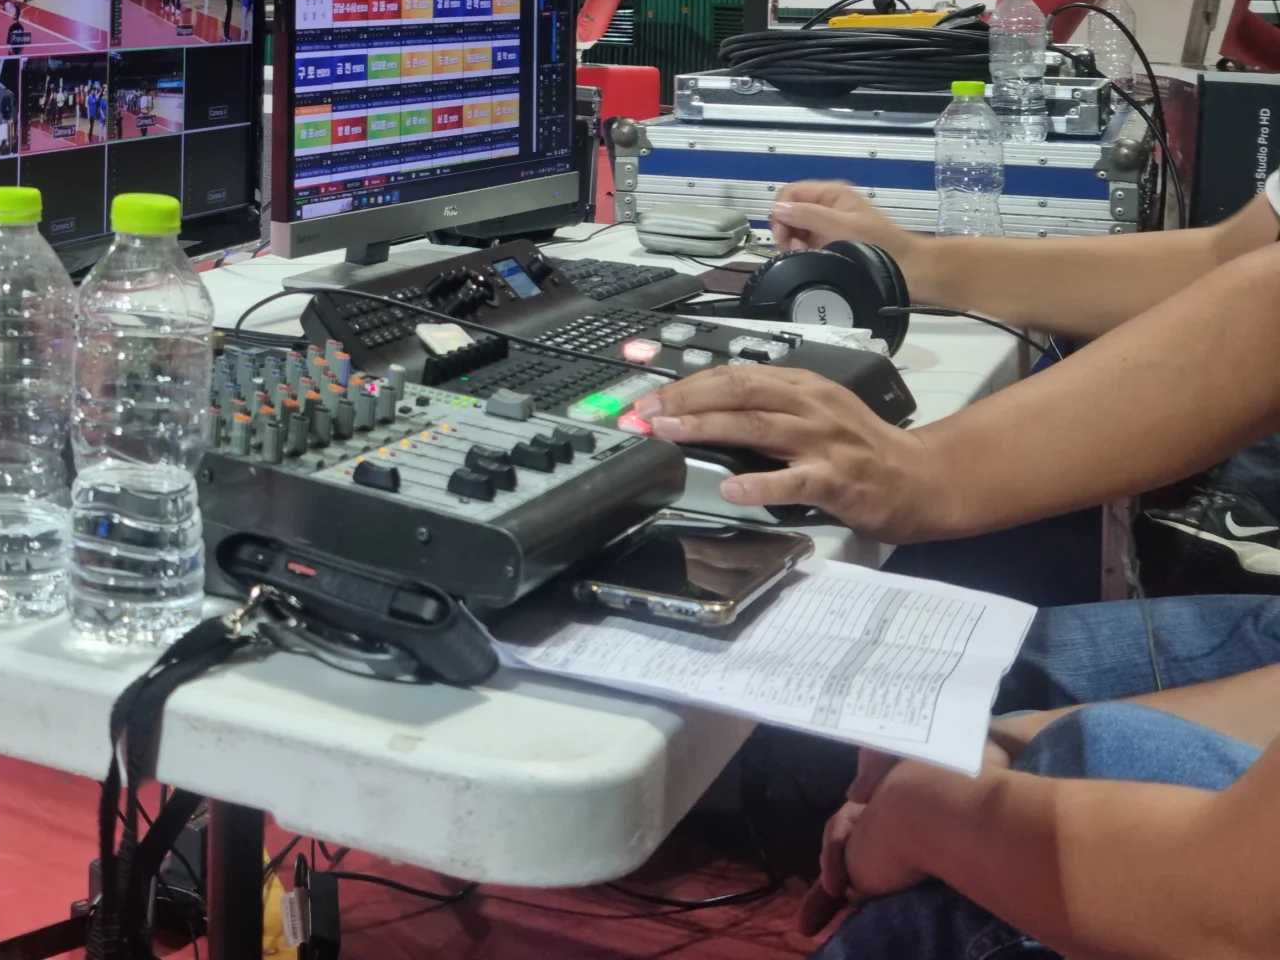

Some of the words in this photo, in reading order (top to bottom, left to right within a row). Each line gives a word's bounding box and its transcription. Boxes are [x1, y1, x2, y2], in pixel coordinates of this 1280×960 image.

[1258, 108, 1271, 125] HD
[1257, 127, 1270, 144] Pro
[1255, 147, 1269, 179] Studio
